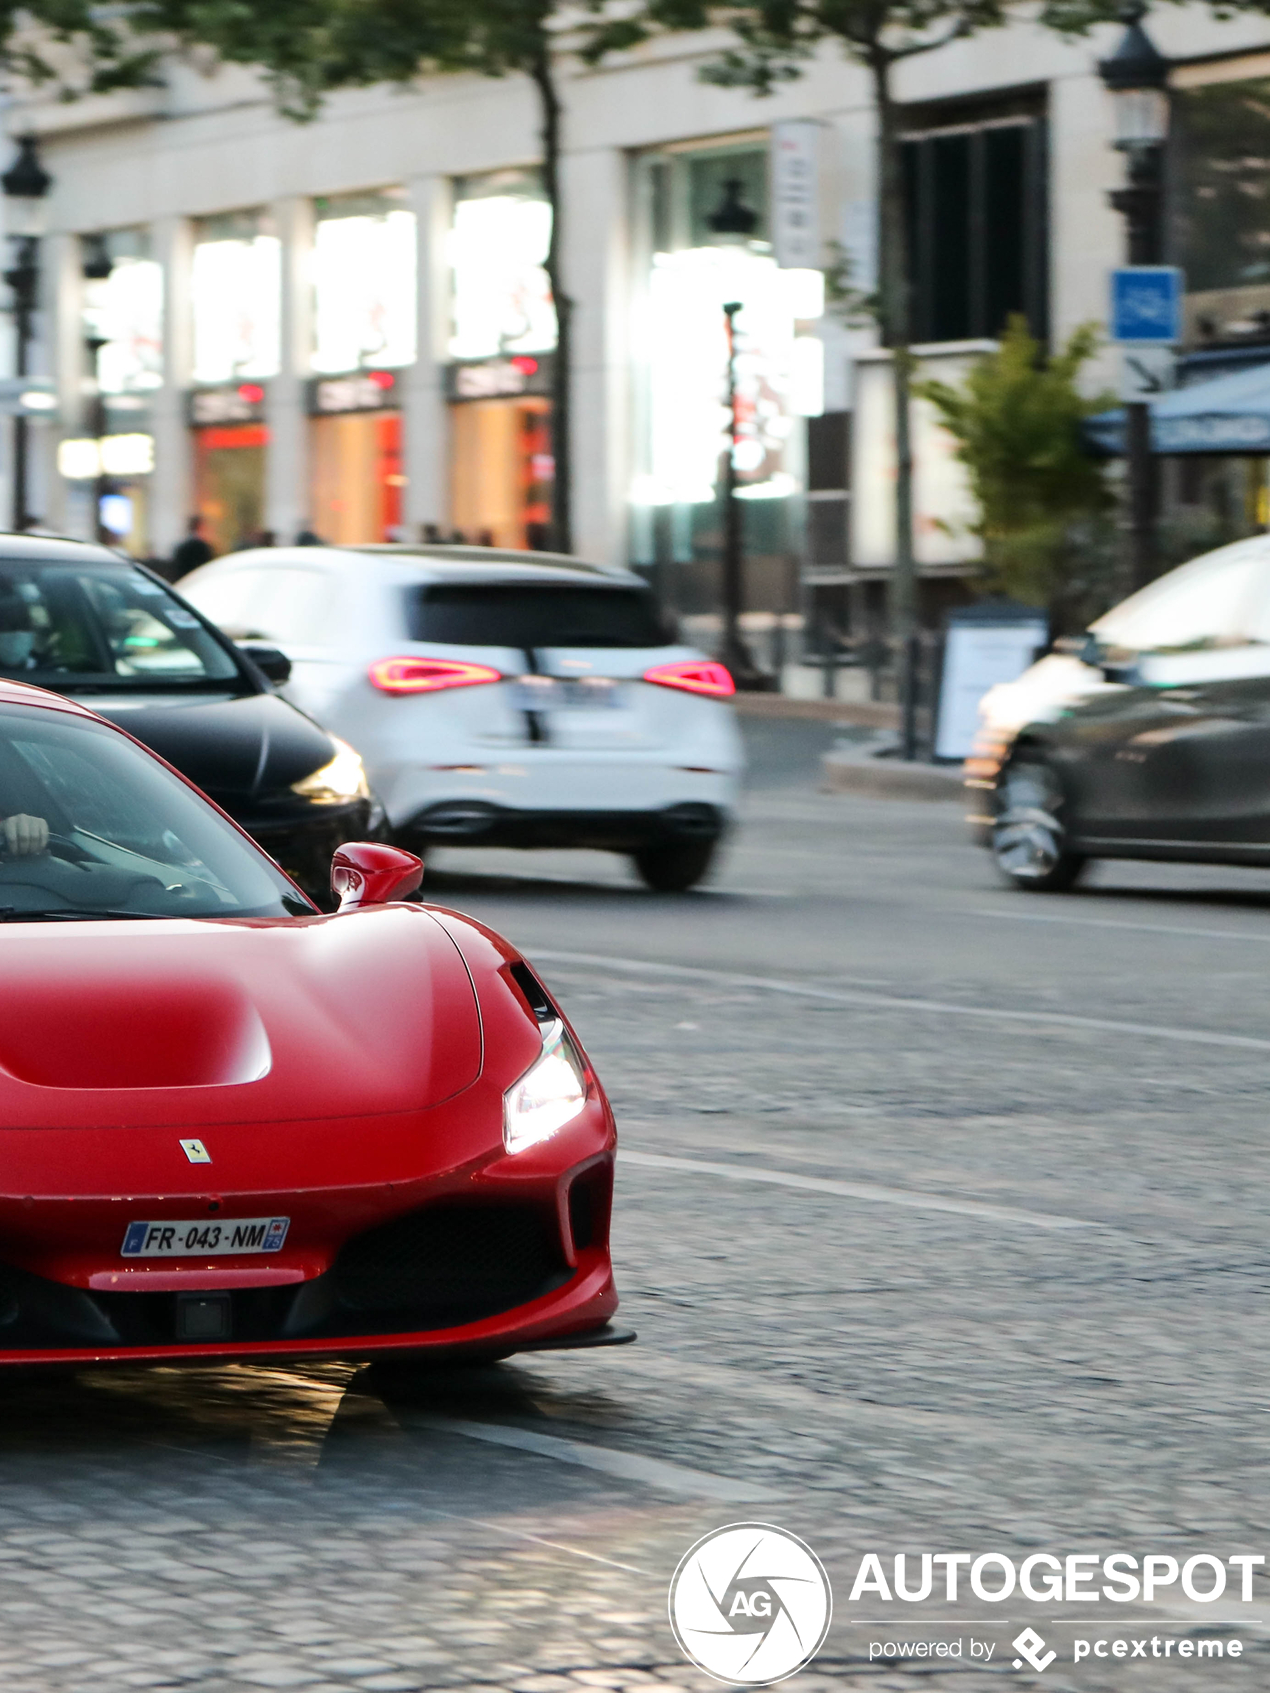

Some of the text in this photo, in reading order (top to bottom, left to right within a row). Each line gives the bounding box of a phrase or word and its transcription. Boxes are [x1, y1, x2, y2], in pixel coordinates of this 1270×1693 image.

[129, 1225, 282, 1250] F FR-043-NM 75
